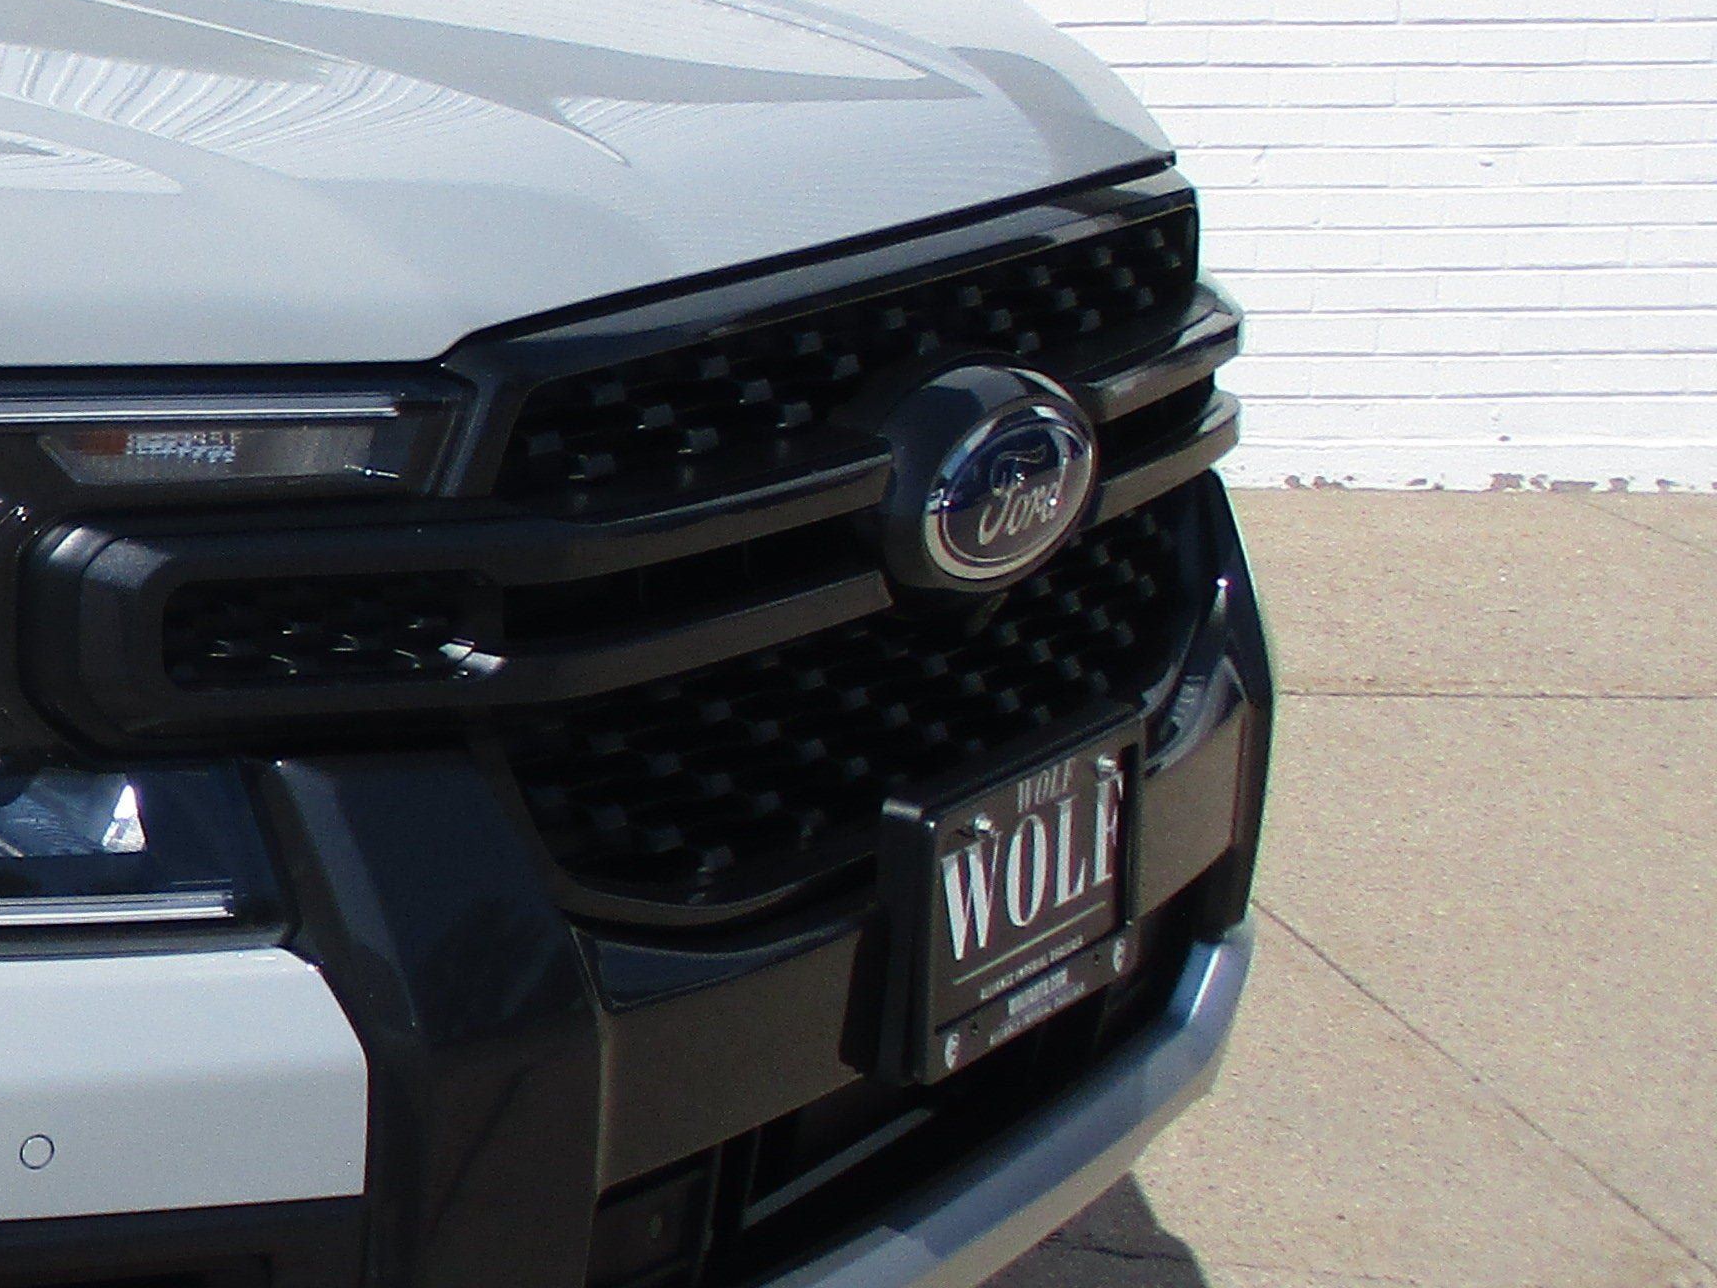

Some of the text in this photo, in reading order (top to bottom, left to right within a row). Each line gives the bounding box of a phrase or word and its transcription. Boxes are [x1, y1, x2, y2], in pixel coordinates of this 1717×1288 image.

[978, 443, 1068, 546] Ford
[1017, 757, 1077, 813] WOLF
[941, 770, 1124, 961] WOLF
